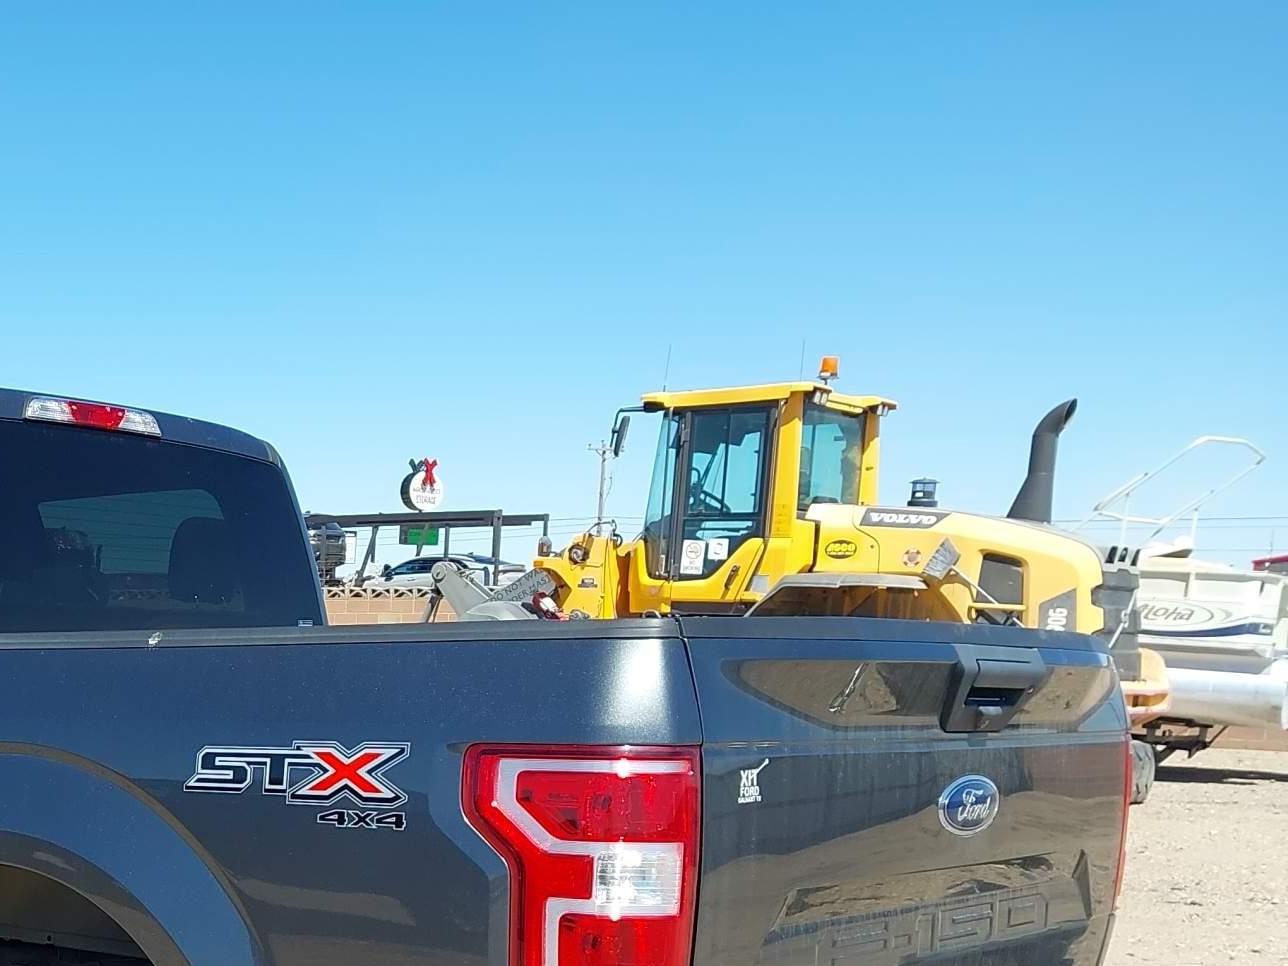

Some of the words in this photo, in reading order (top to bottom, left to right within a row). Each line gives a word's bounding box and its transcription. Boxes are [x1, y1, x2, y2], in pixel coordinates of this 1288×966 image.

[870, 512, 937, 525] VOLVO
[184, 741, 410, 808] STX
[740, 785, 760, 797] FORD
[957, 788, 992, 821] Ford
